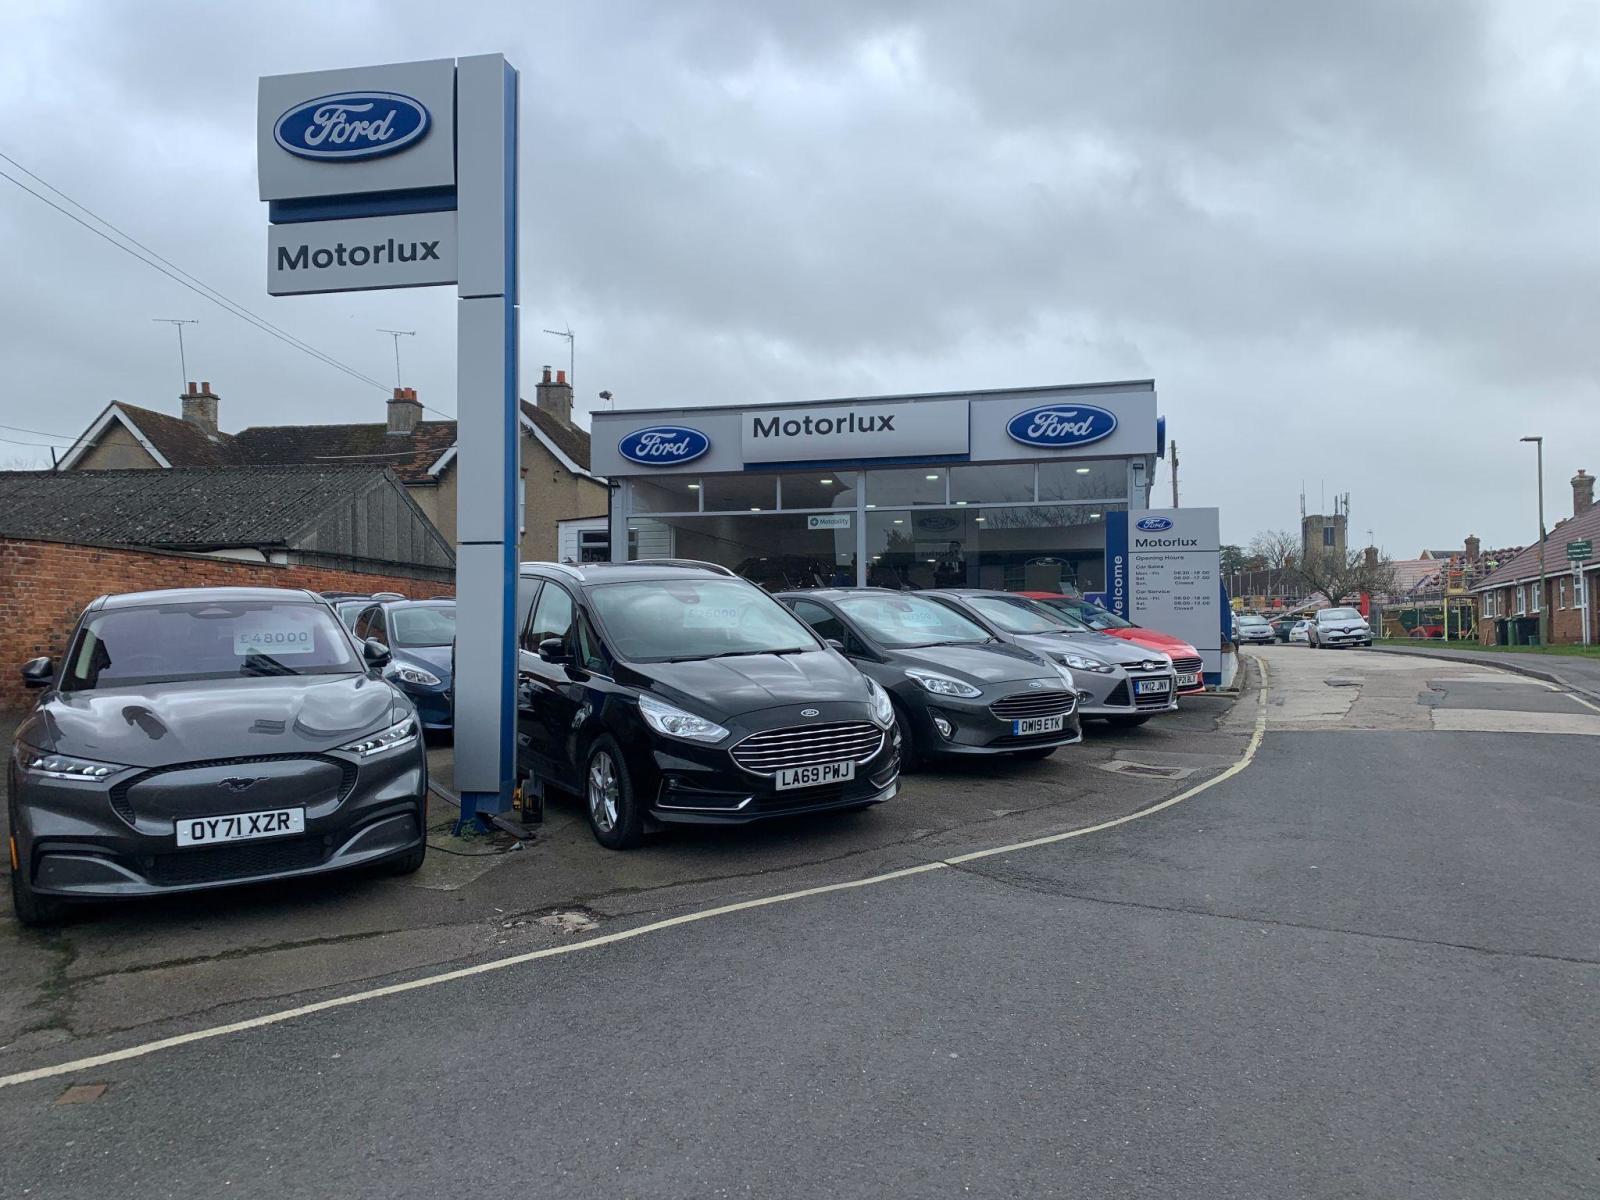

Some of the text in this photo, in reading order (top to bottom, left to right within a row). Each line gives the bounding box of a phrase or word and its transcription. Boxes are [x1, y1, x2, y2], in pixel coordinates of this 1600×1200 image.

[304, 102, 395, 146] Ford
[277, 238, 440, 271] Motorlux
[753, 412, 895, 438] Motorlux
[1027, 410, 1093, 438] Ford
[635, 431, 689, 457] Ford
[1143, 519, 1166, 529] Ford
[1135, 537, 1198, 548] Motorlux
[240, 631, 308, 644] £48000
[1044, 716, 1060, 730] ETK
[782, 762, 850, 787] LA69 PWJ
[191, 811, 290, 841] OY71 XZR
